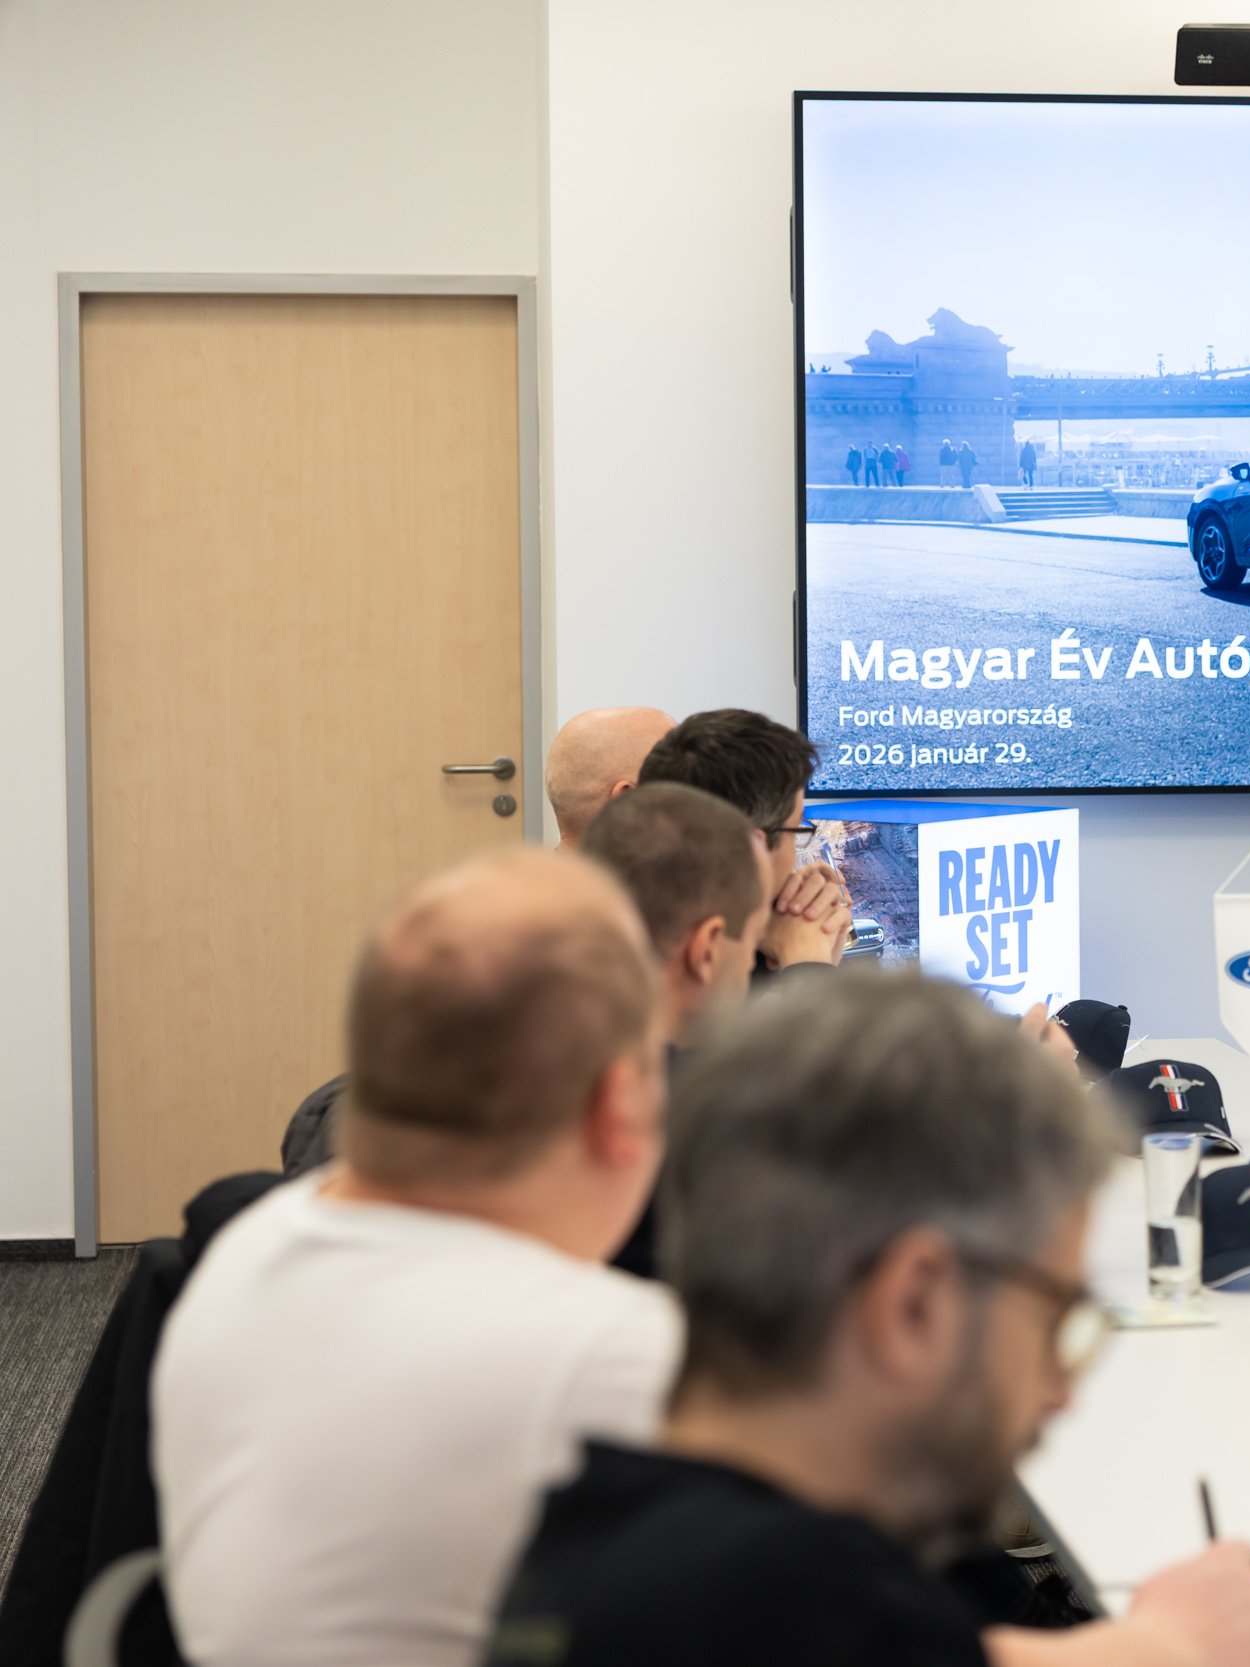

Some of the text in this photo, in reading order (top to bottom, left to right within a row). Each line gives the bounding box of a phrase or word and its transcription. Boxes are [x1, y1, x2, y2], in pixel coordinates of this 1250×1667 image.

[840, 639, 1036, 690] Magyar
[1050, 627, 1113, 680] Év
[838, 703, 1073, 730] Ford Magyarország
[838, 742, 1032, 769] 2026 január 29.
[939, 839, 1061, 917] READY
[966, 908, 1033, 981] SET
